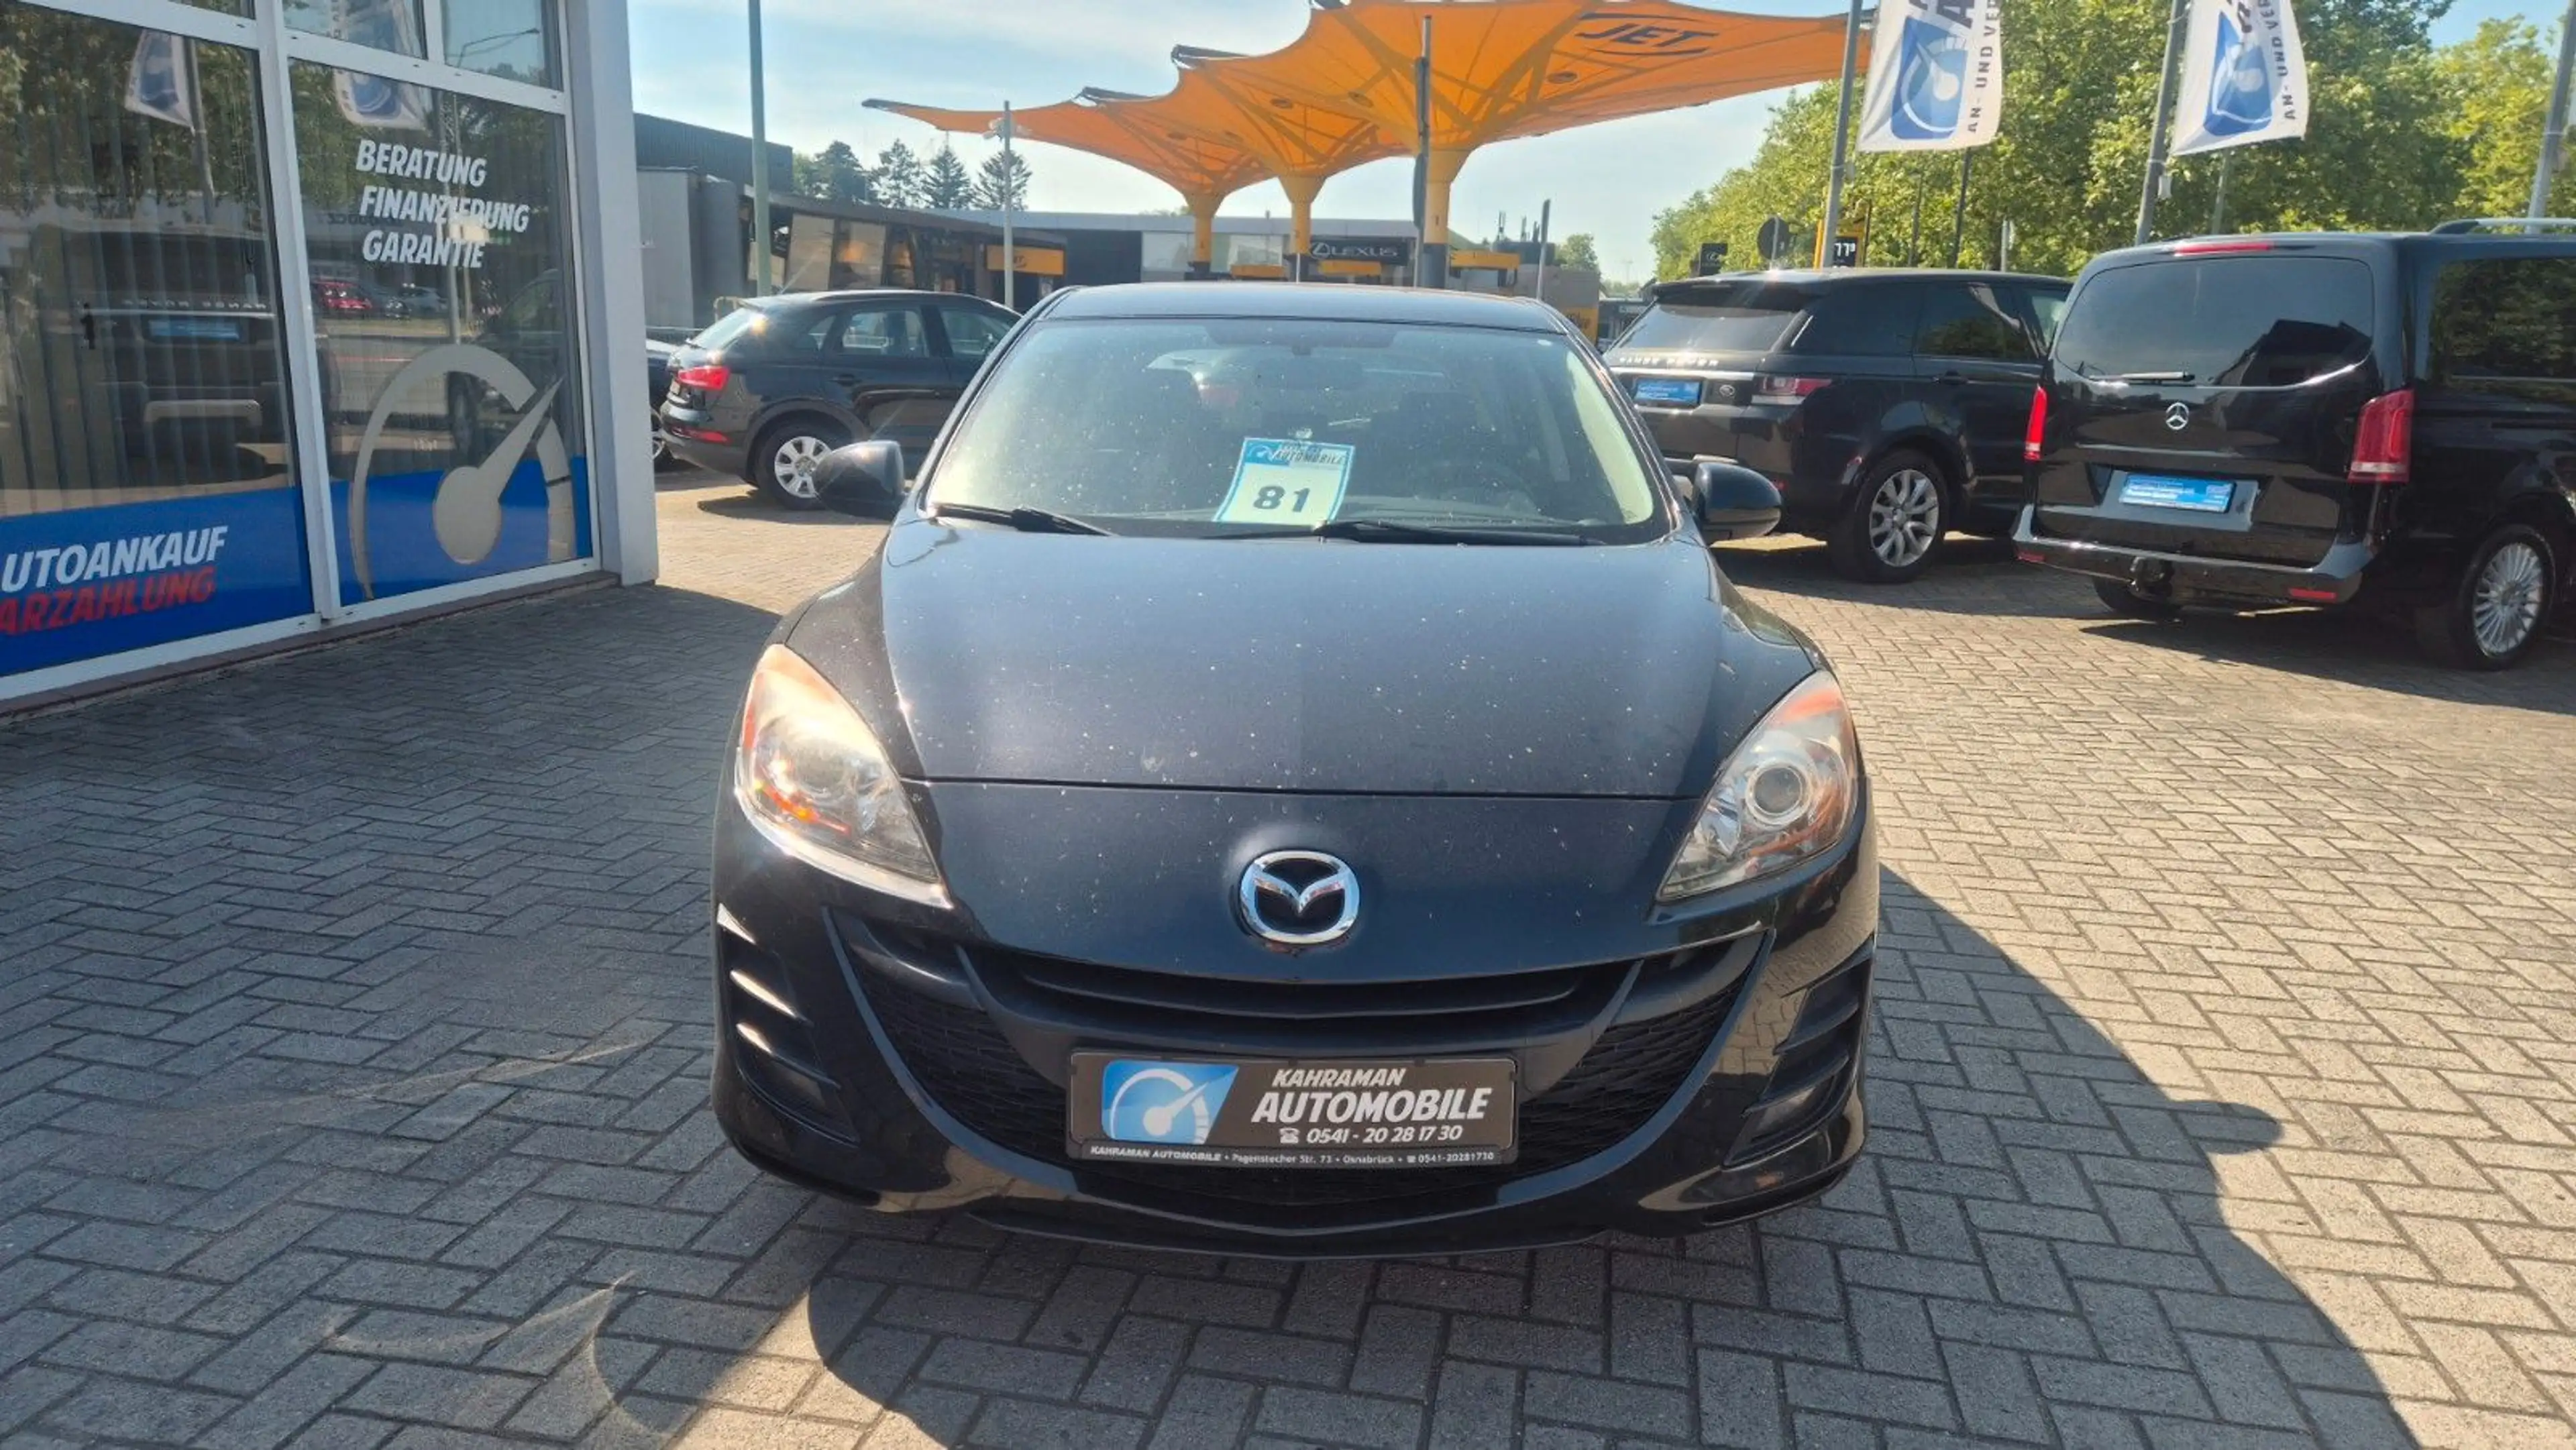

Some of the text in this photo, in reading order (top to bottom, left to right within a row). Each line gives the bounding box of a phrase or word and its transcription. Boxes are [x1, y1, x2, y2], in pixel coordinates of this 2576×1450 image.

[1574, 22, 1719, 48] JET
[1975, 46, 1993, 89] UND
[2271, 37, 2288, 77] UND
[356, 140, 487, 187] BERATUNG
[359, 185, 531, 233] FINANZIERUNG
[362, 230, 486, 268] GARANTIE
[1332, 245, 1399, 257] LEXUS
[1252, 486, 1311, 513] 81
[1272, 1068, 1407, 1088] KAHRAMAN
[1251, 1088, 1493, 1123] AUTOMOBILE
[1307, 1128, 1350, 1144] 0541
[1362, 1127, 1389, 1143] 20
[1391, 1127, 1415, 1142] 28
[1418, 1126, 1436, 1141] 17
[1438, 1125, 1463, 1141] 30
[1090, 1146, 1150, 1158] KAHRAMAN
[1152, 1150, 1222, 1162] AUTOMOBILE
[1342, 1154, 1394, 1164] Osnabrück
